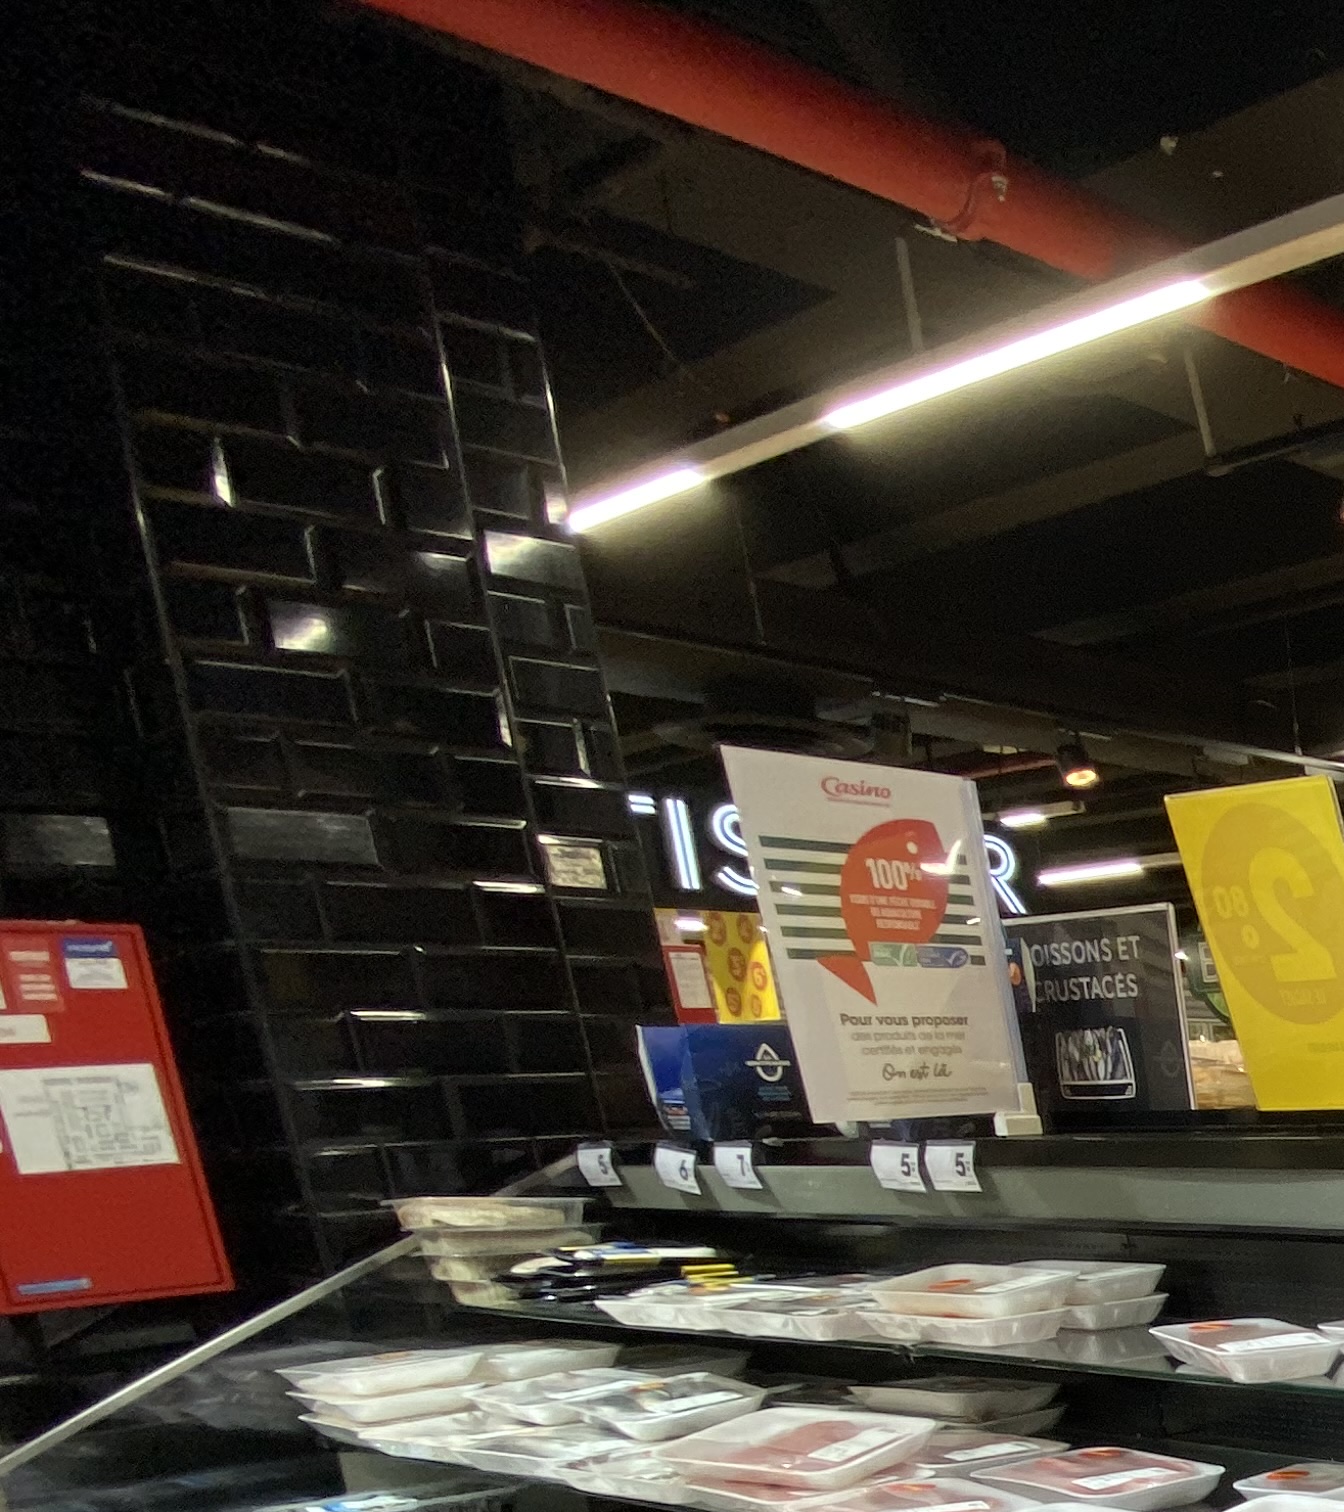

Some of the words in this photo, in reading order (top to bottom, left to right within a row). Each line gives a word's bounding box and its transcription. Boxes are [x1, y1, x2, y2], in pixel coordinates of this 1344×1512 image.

[821, 776, 891, 800] Casino
[866, 858, 922, 892] 100%
[1030, 937, 1112, 967] OISSONS
[1116, 936, 1140, 960] ET
[1036, 972, 1139, 1002] CRUSTACÉS
[839, 1014, 872, 1026] Pour
[878, 1016, 909, 1026] vous
[912, 1016, 968, 1029] proposer
[679, 1159, 689, 1181] 6
[736, 1154, 746, 1176] 7
[900, 1153, 911, 1177] 5
[955, 1152, 966, 1177] 5
